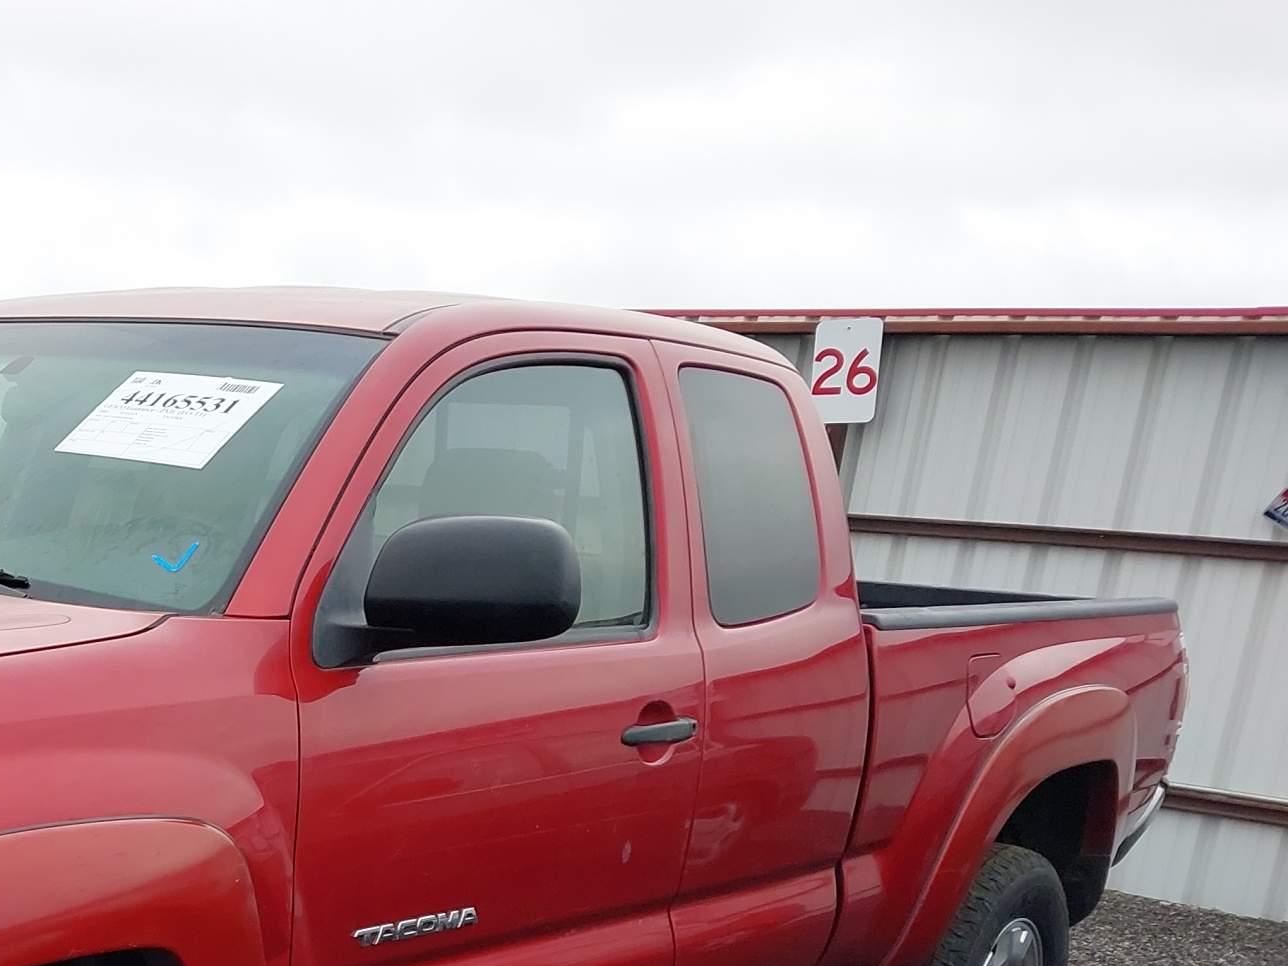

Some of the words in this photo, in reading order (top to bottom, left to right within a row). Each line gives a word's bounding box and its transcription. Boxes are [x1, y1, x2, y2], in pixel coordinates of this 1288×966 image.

[811, 347, 878, 396] 26
[120, 390, 240, 415] 44165531
[351, 906, 479, 947] TACOMA
